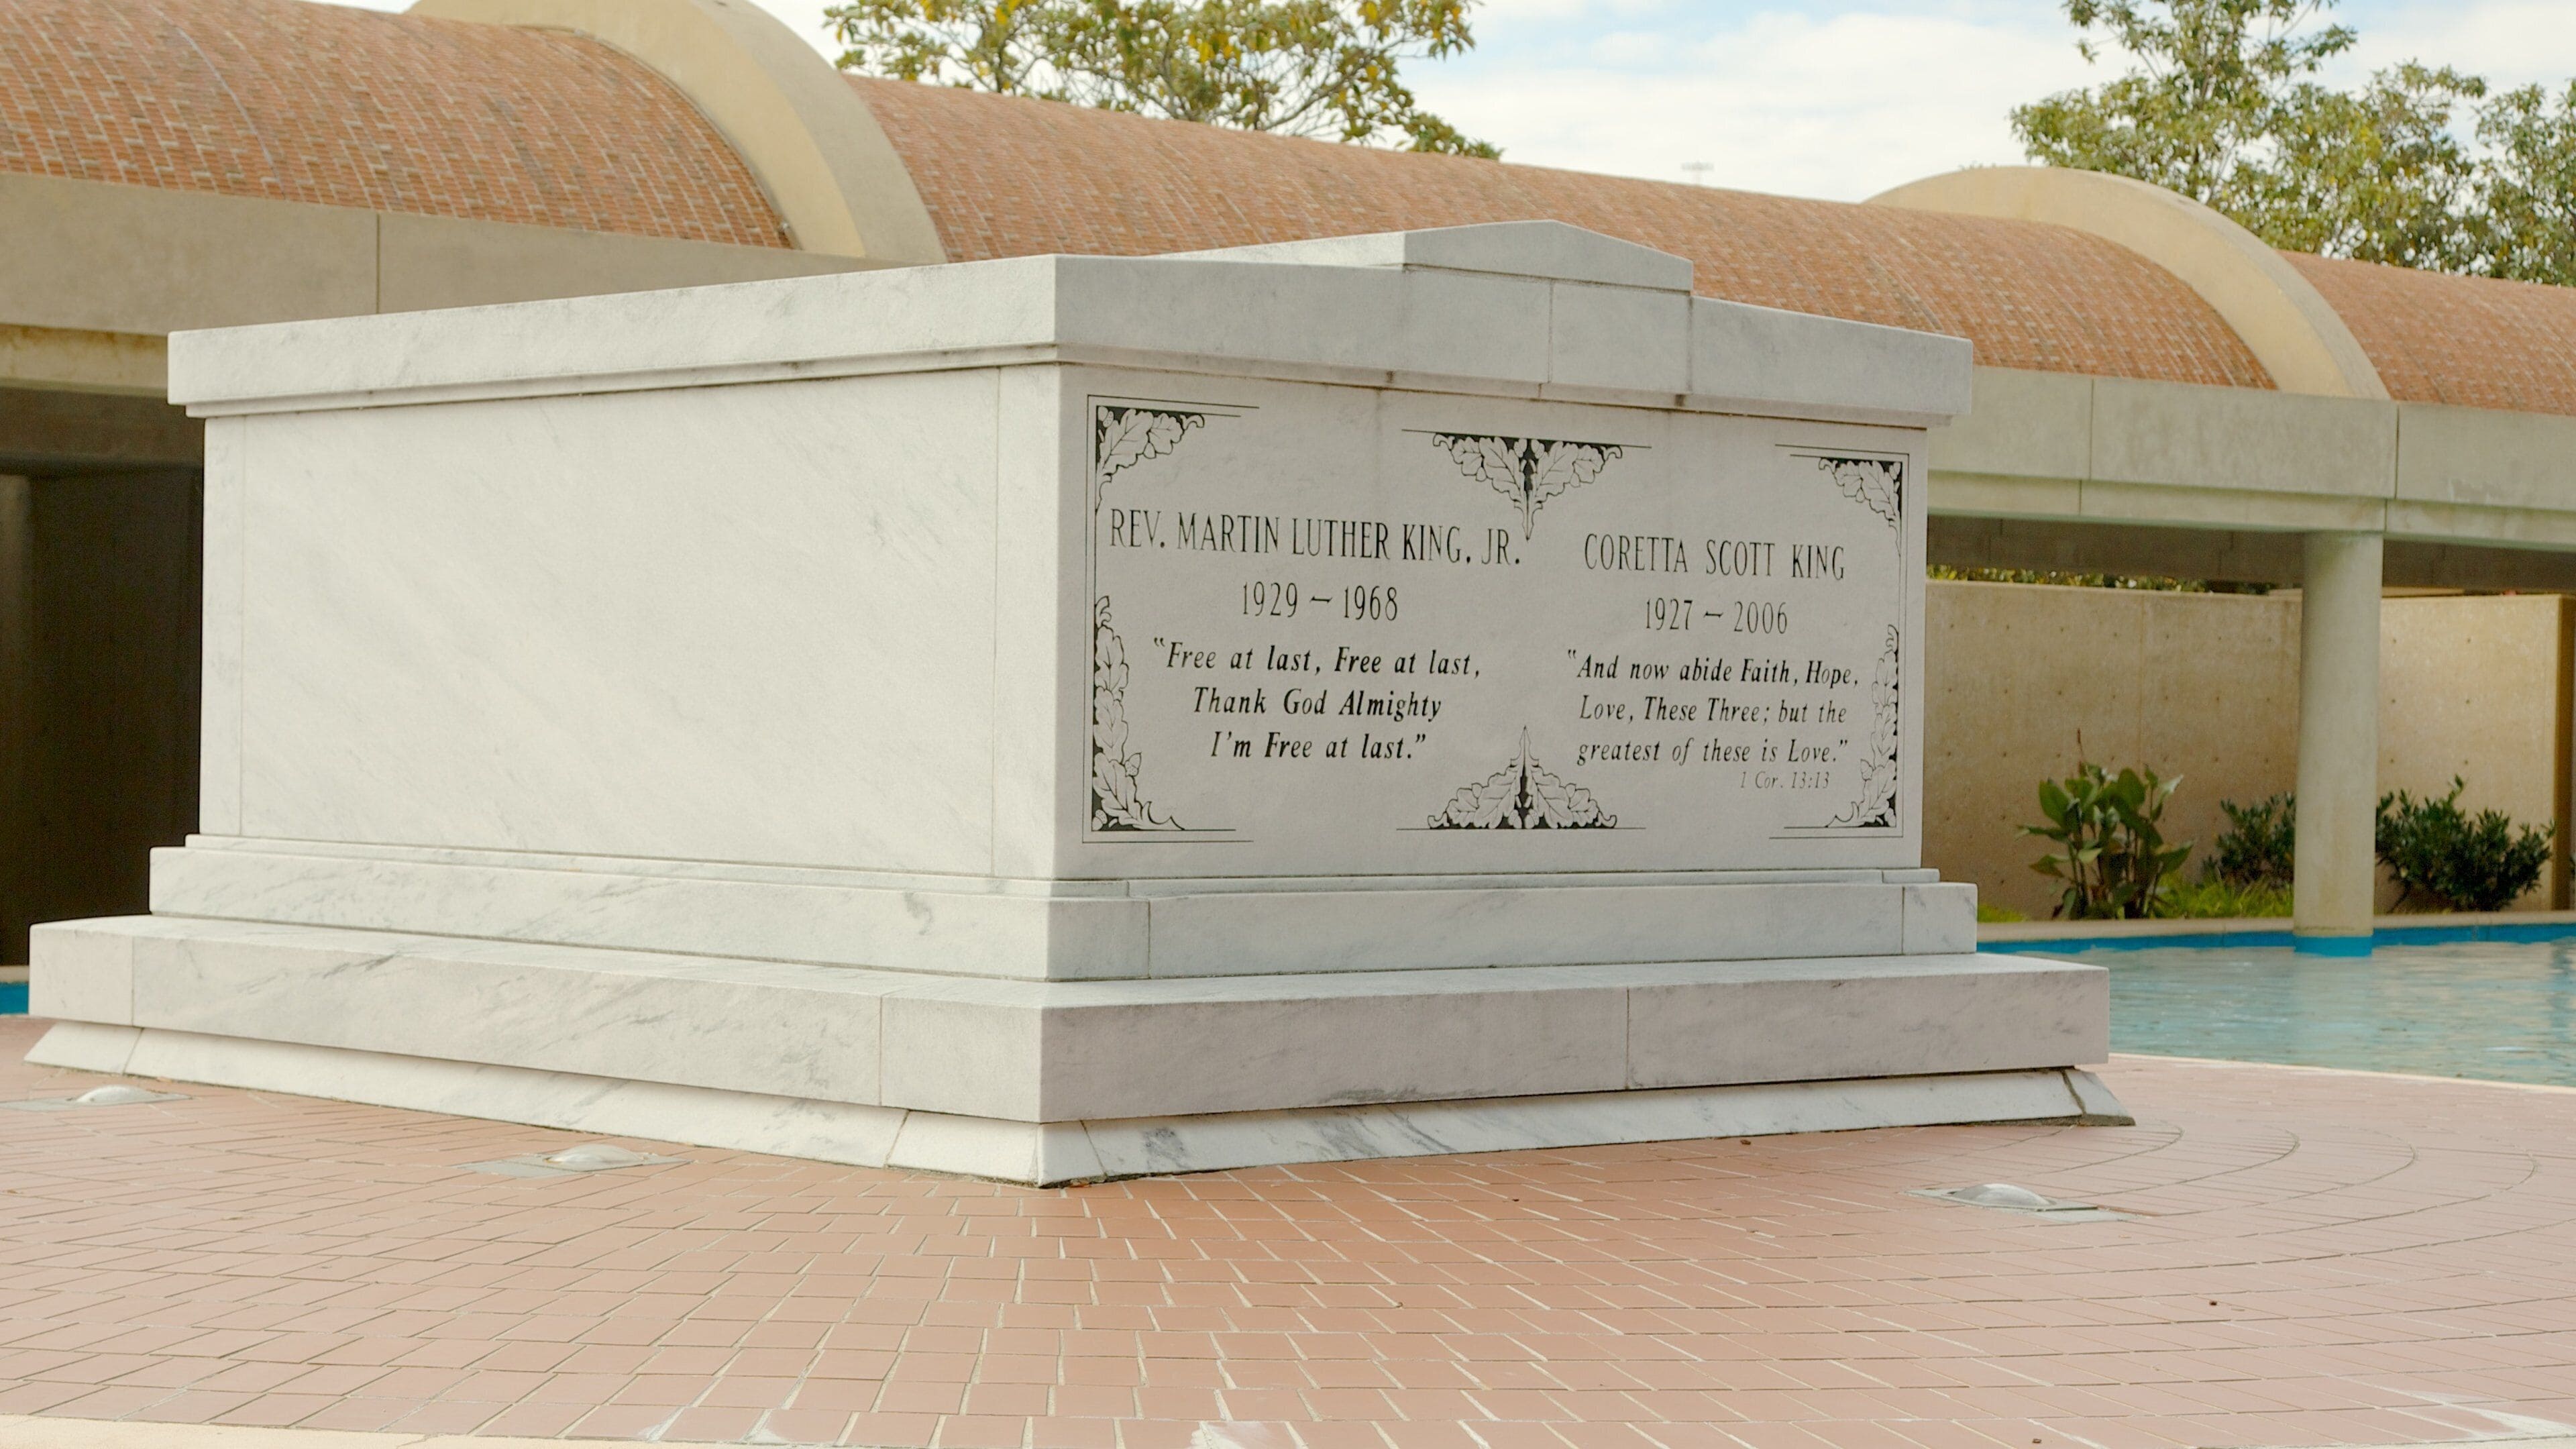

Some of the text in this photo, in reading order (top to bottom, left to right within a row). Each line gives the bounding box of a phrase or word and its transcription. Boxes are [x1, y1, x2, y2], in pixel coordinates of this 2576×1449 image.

[1110, 508, 1521, 566] REV. MARTIN LUTHER KING, JR.
[1584, 533, 1845, 582] CORETTA SCOTT KING
[1242, 580, 1298, 618] 1929
[1343, 584, 1398, 622] 1968
[1646, 597, 1693, 631] 1927
[1733, 600, 1788, 635] 2006
[1230, 647, 1254, 670] at
[1267, 644, 1321, 676] last,
[1334, 646, 1382, 674] Free
[1393, 652, 1417, 674] at
[1429, 649, 1480, 680] last,
[1629, 663, 1670, 680] now
[1679, 656, 1732, 682] abide
[1739, 657, 1799, 687] Faith,
[1805, 659, 1858, 690] Hope,
[1193, 686, 1442, 723] Thank God Almighty
[1578, 694, 1847, 726] Love, These Three; but the
[1264, 731, 1313, 759] Free
[1325, 737, 1348, 759] at
[1576, 741, 1660, 767] greatest
[1672, 737, 1695, 767] of
[1703, 737, 1751, 763] these
[1761, 738, 1778, 763] is
[1755, 770, 1784, 790] Cor.
[1790, 771, 1830, 790] 13:13
